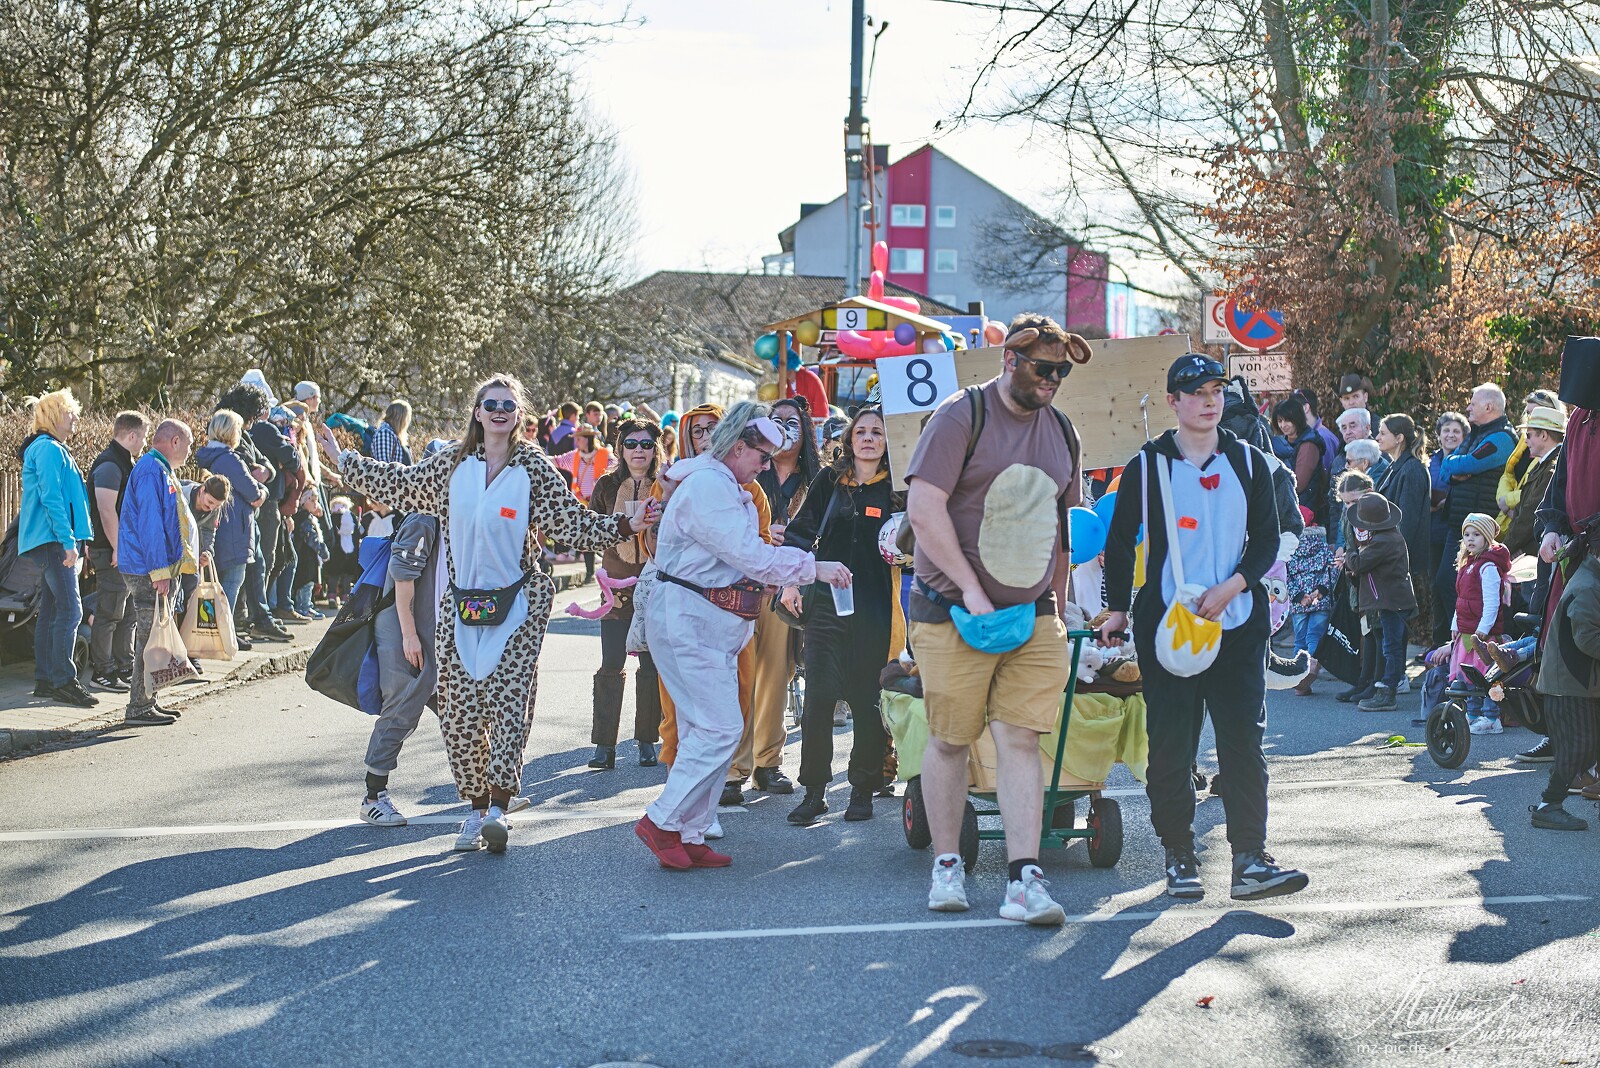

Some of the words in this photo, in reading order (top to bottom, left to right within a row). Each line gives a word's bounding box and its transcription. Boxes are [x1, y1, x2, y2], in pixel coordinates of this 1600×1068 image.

[845, 310, 858, 328] 9
[1238, 362, 1262, 371] von
[906, 358, 938, 407] 8
